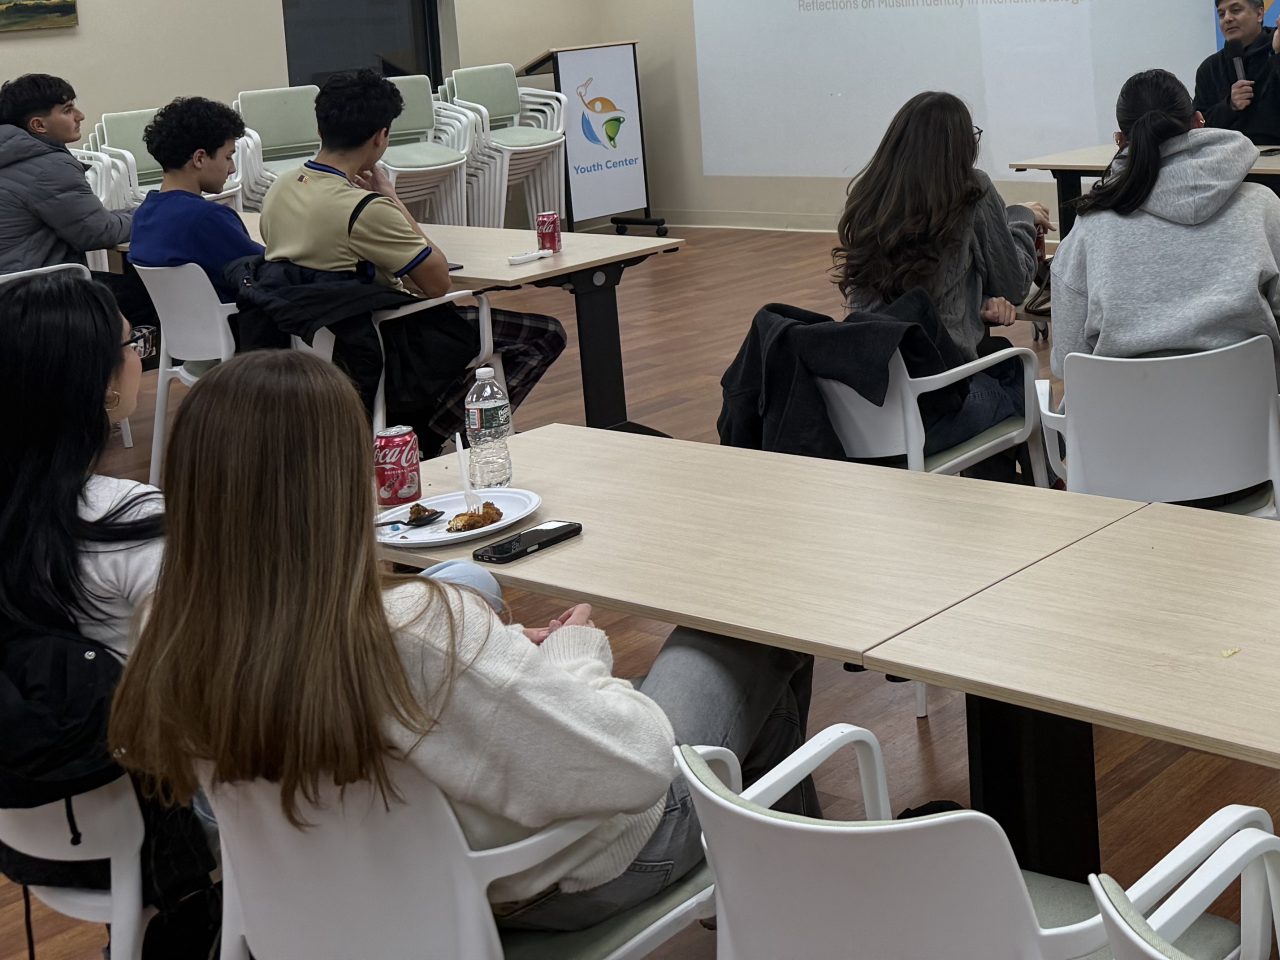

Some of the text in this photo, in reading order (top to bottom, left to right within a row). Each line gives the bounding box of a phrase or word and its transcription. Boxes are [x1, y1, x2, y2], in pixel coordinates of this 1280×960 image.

[860, 0, 875, 9] on
[574, 157, 639, 175] Youth Center
